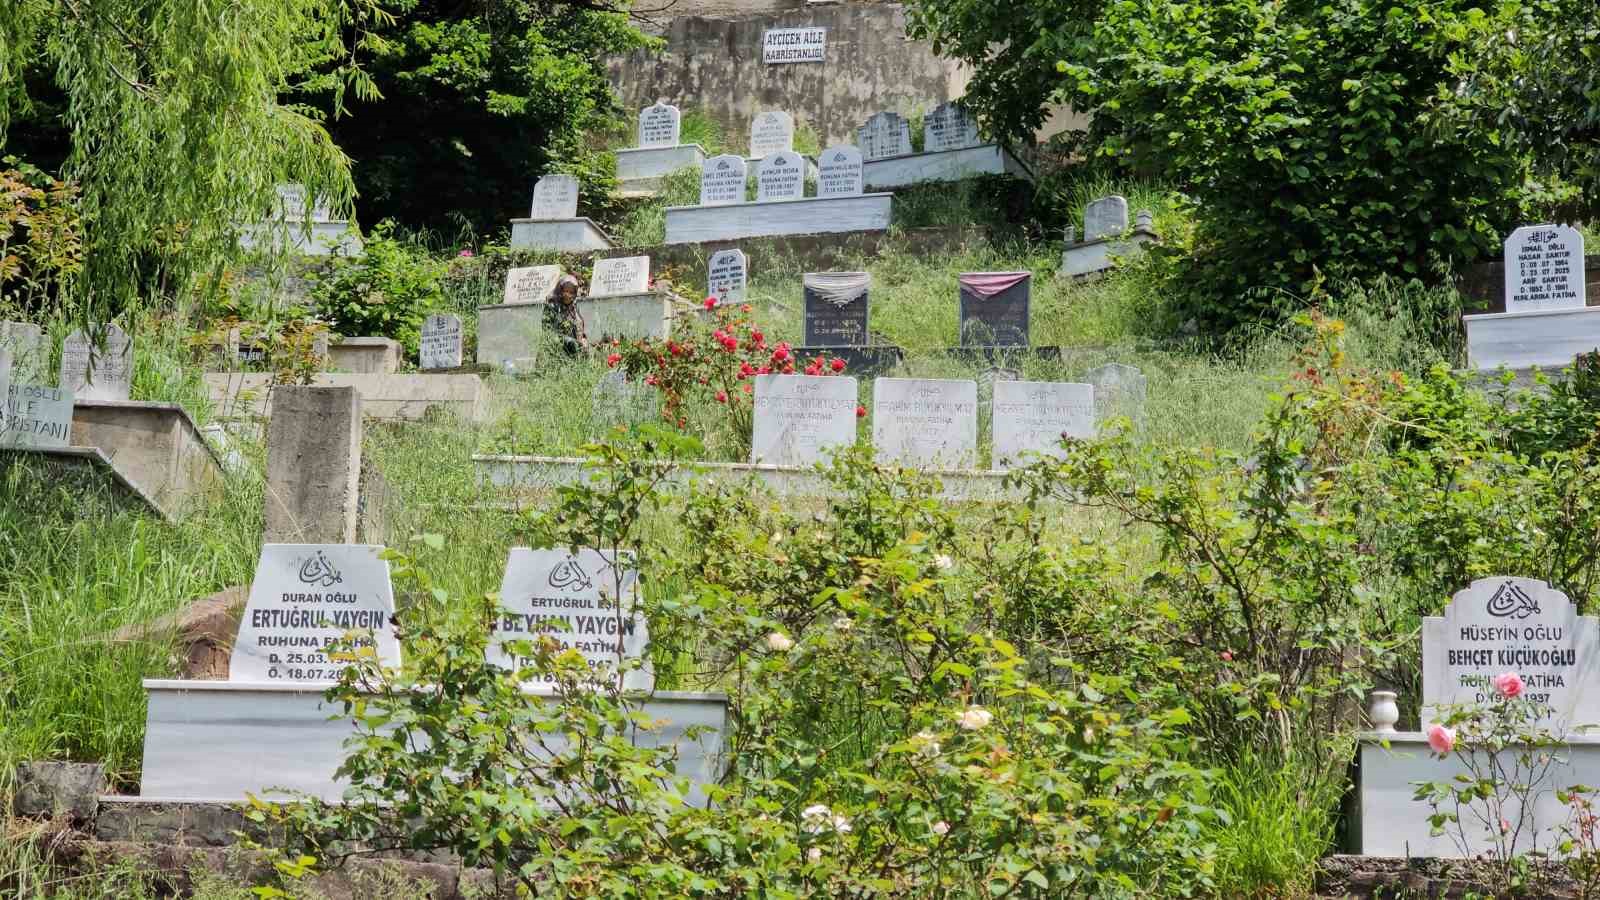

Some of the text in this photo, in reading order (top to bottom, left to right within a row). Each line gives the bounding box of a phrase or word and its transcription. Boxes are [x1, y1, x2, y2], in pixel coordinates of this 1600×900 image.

[282, 591, 357, 604] DURAN OĞLU
[531, 597, 595, 609] ERTUĞRUL
[252, 606, 384, 629] ERTUĞRUL YAYGIN
[1460, 623, 1562, 641] HÜSEYİN OĞLU
[258, 636, 319, 647] RUHUNA
[1449, 645, 1576, 670] BEHÇET KÜÇÜKOĞLU
